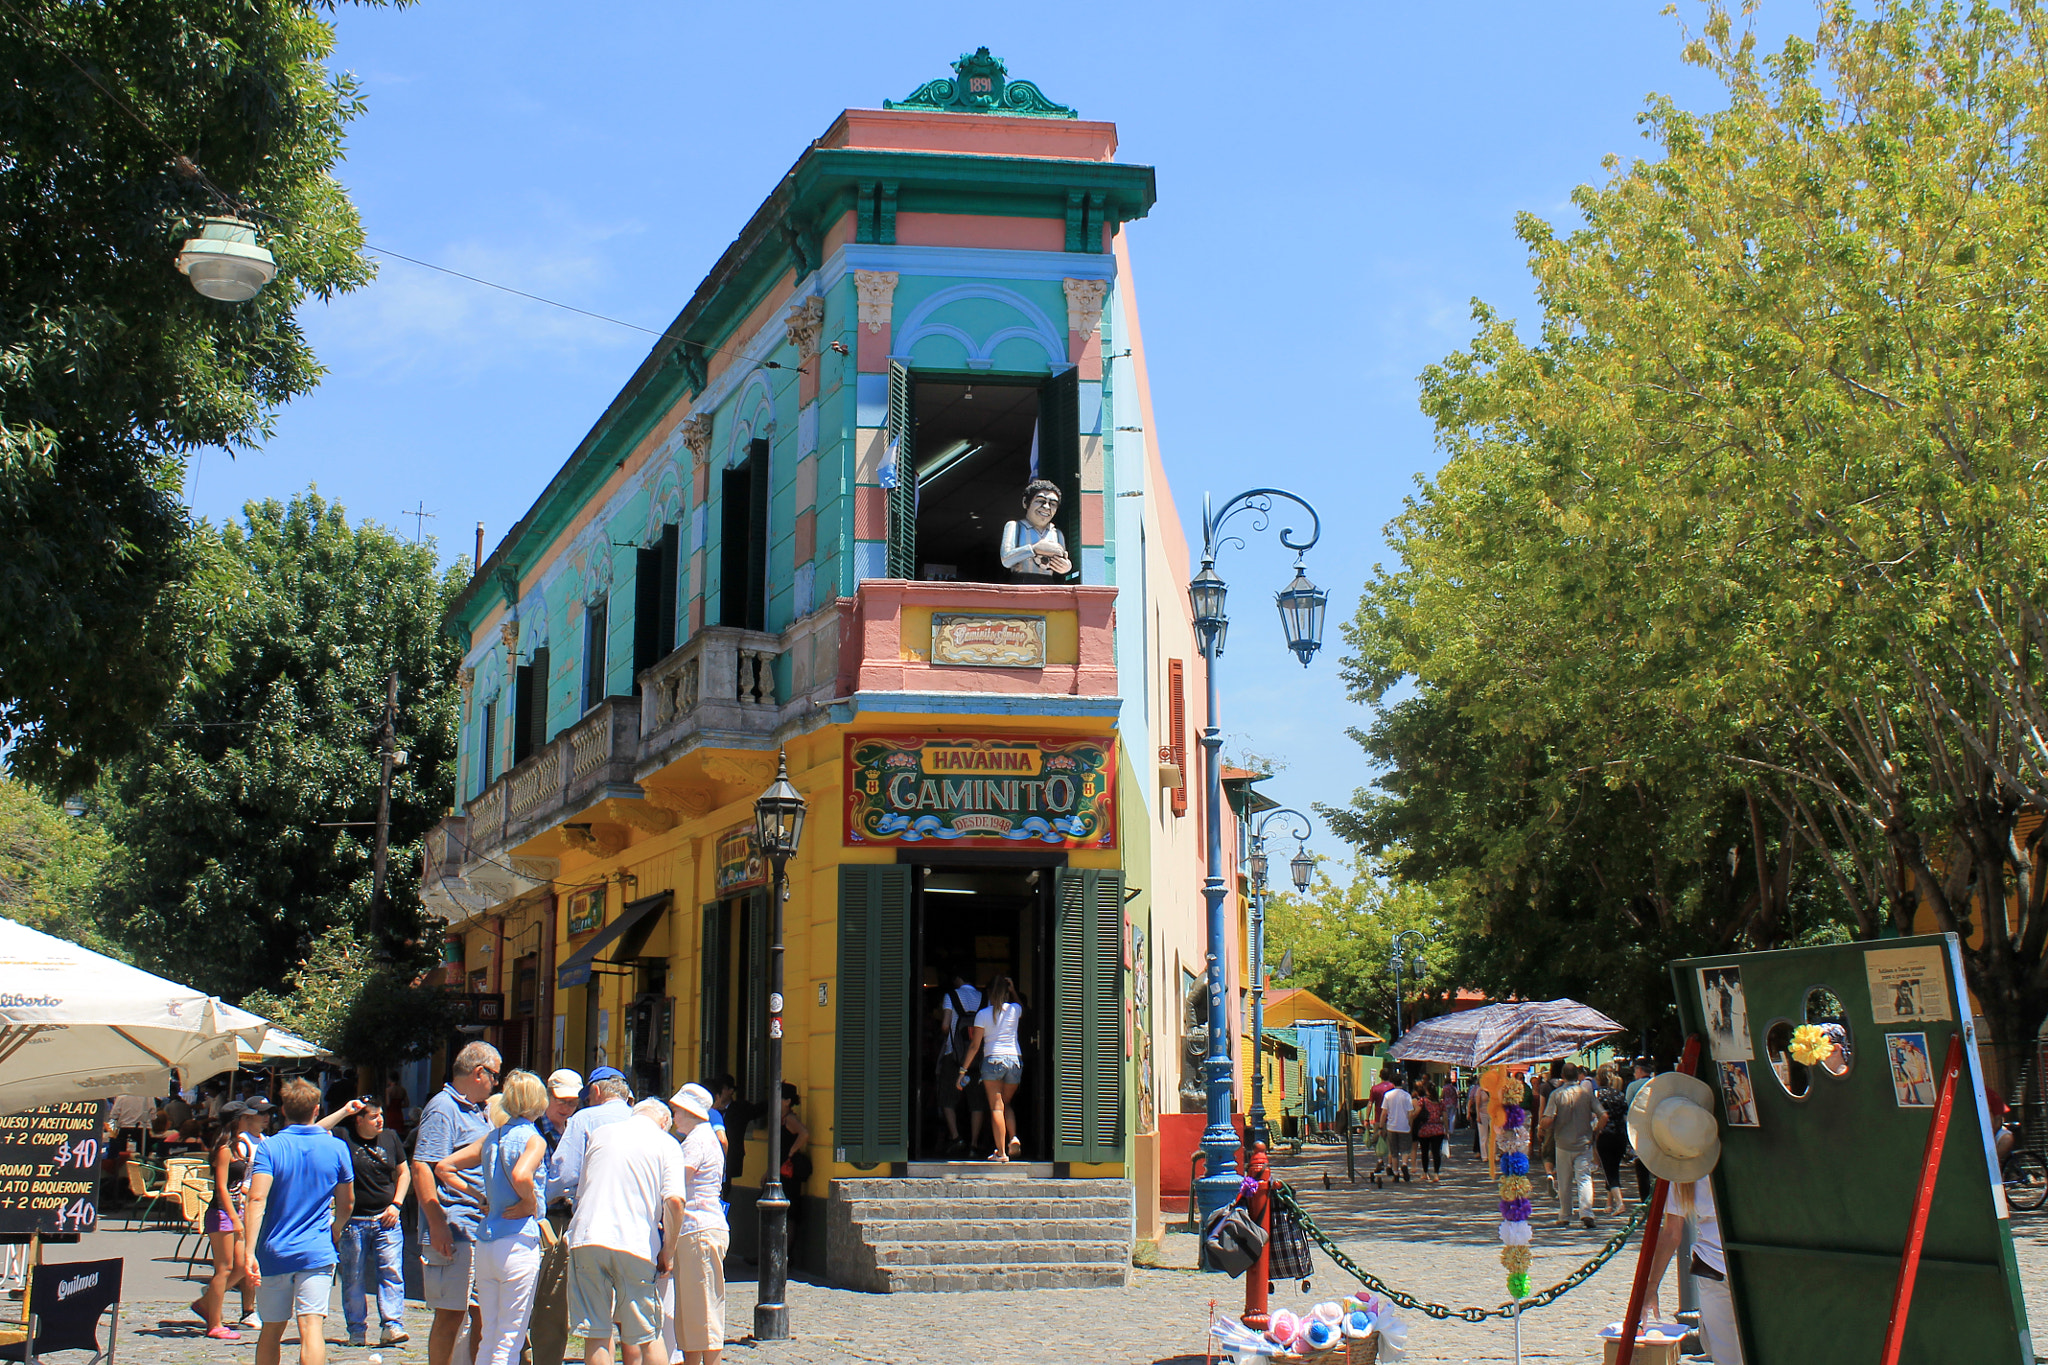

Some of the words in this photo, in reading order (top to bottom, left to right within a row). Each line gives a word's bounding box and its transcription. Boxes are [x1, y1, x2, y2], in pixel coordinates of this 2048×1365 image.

[969, 77, 991, 92] 1891
[932, 751, 1033, 771] HAVANNA
[868, 781, 877, 793] H
[887, 772, 1076, 812] CAMINITO
[1083, 783, 1092, 794] H
[954, 816, 990, 833] DESDE
[990, 817, 1013, 833] 1948
[0, 992, 64, 1008] liberto
[59, 1102, 98, 1114] PLATO
[30, 1117, 40, 1129] Y
[38, 1117, 95, 1130] ACEITUNAS
[16, 1132, 29, 1145] 2
[31, 1133, 69, 1146] CHOPP
[53, 1138, 98, 1169] $40
[0, 1163, 34, 1177] ROMO
[0, 1180, 30, 1193] LATO
[31, 1180, 94, 1195] BOQUERONE
[17, 1196, 29, 1209] 2
[31, 1196, 69, 1209] CHOPP
[54, 1197, 96, 1230] $40
[57, 1271, 99, 1301] Quilmes
